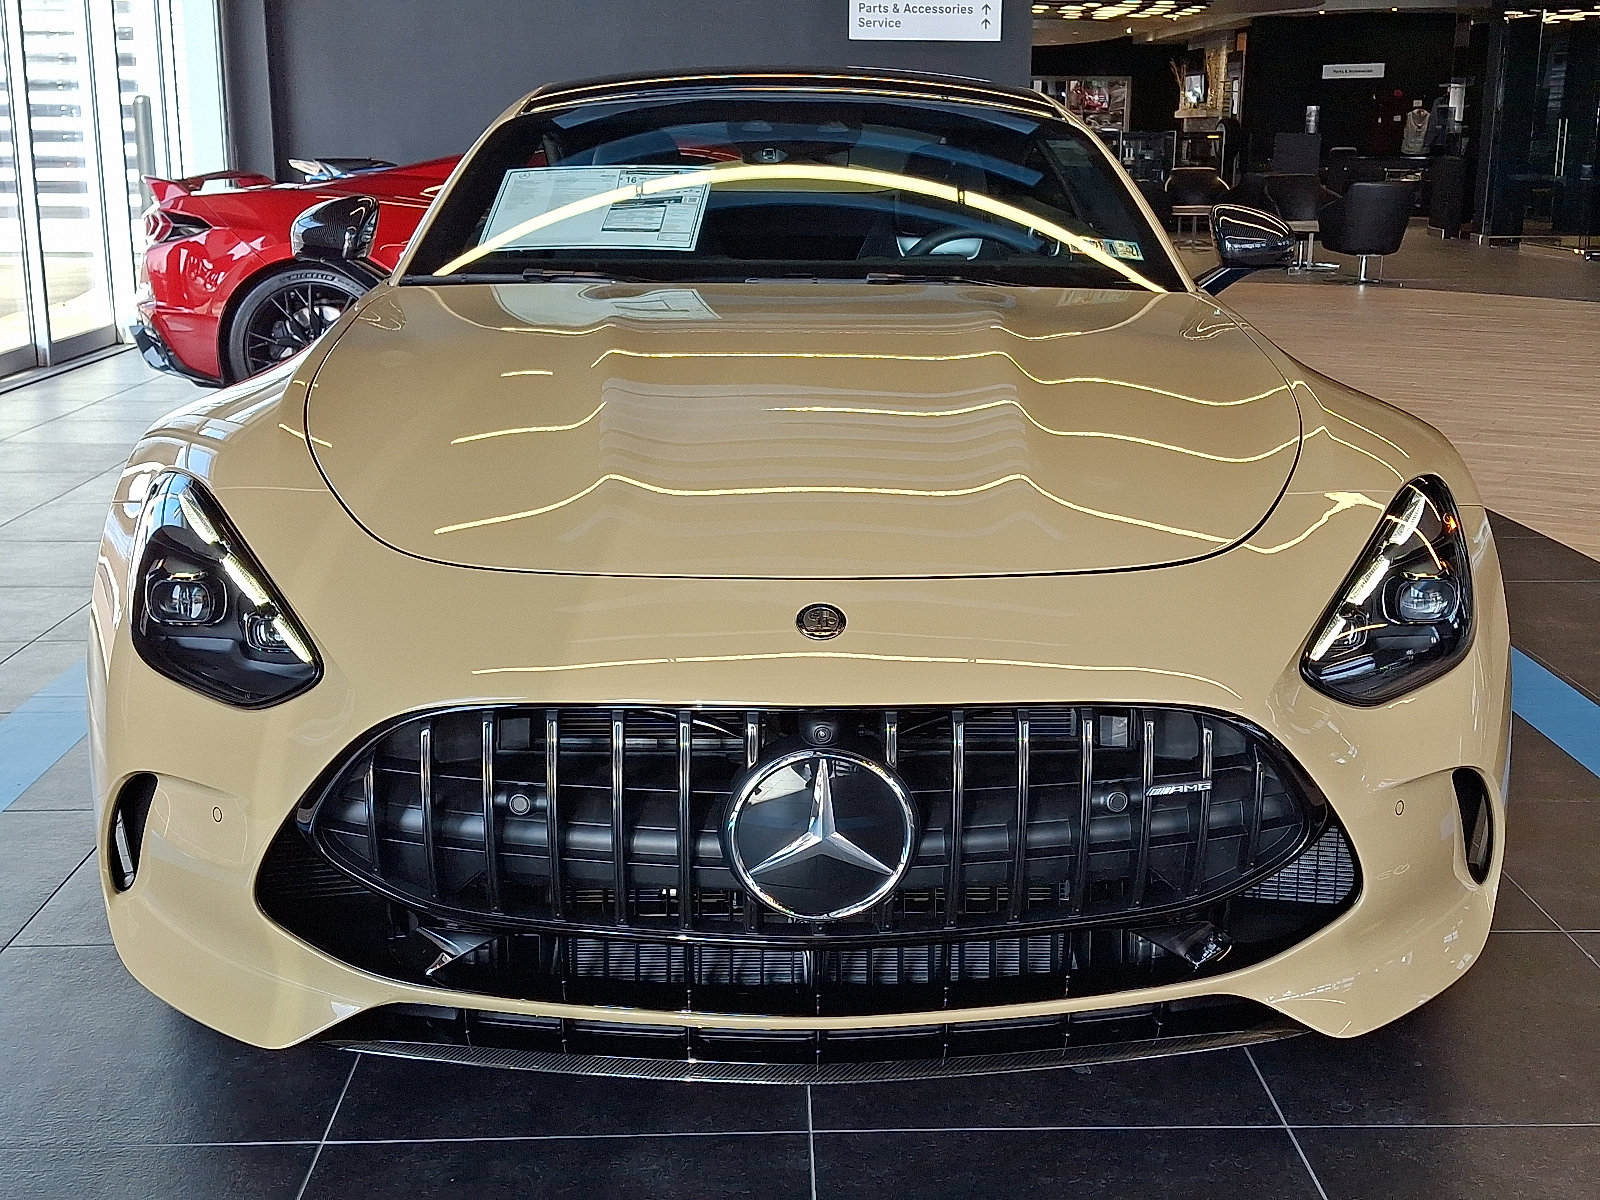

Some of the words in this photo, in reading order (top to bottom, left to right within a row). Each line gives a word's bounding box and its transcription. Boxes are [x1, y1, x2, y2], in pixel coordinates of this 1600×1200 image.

[858, 3, 889, 13] Parts
[892, 3, 900, 14] &
[903, 3, 974, 14] Accessories
[858, 17, 902, 28] Service
[626, 176, 637, 184] 16
[290, 272, 334, 281] MICHELIN
